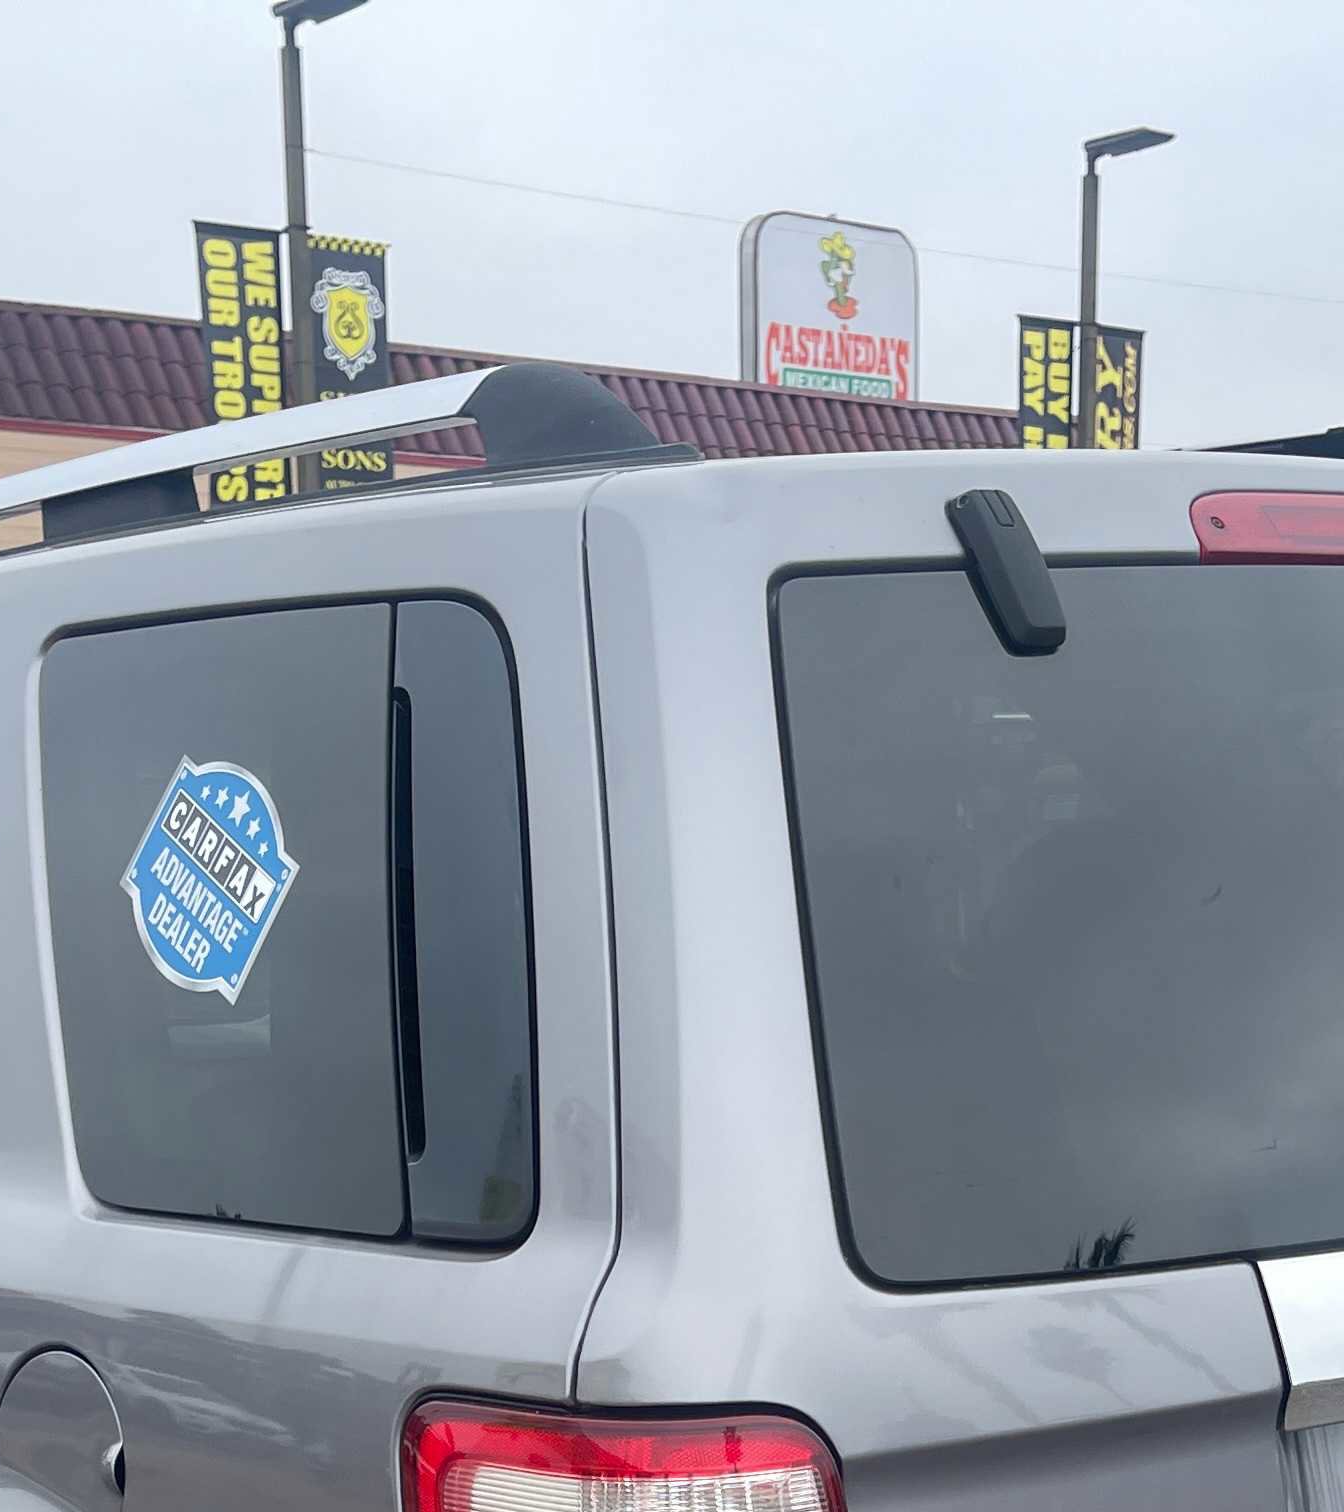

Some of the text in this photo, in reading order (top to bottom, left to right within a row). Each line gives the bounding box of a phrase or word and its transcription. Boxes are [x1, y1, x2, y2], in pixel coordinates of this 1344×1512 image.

[202, 238, 249, 502] OUR TROS
[241, 240, 286, 501] WE SUPRT
[1023, 330, 1046, 417] PAY
[1047, 328, 1071, 424] BUY
[321, 448, 387, 472] SONS
[150, 847, 243, 953] ADVANTAGE
[168, 800, 266, 917] CARFAX
[148, 892, 211, 974] DEALER
